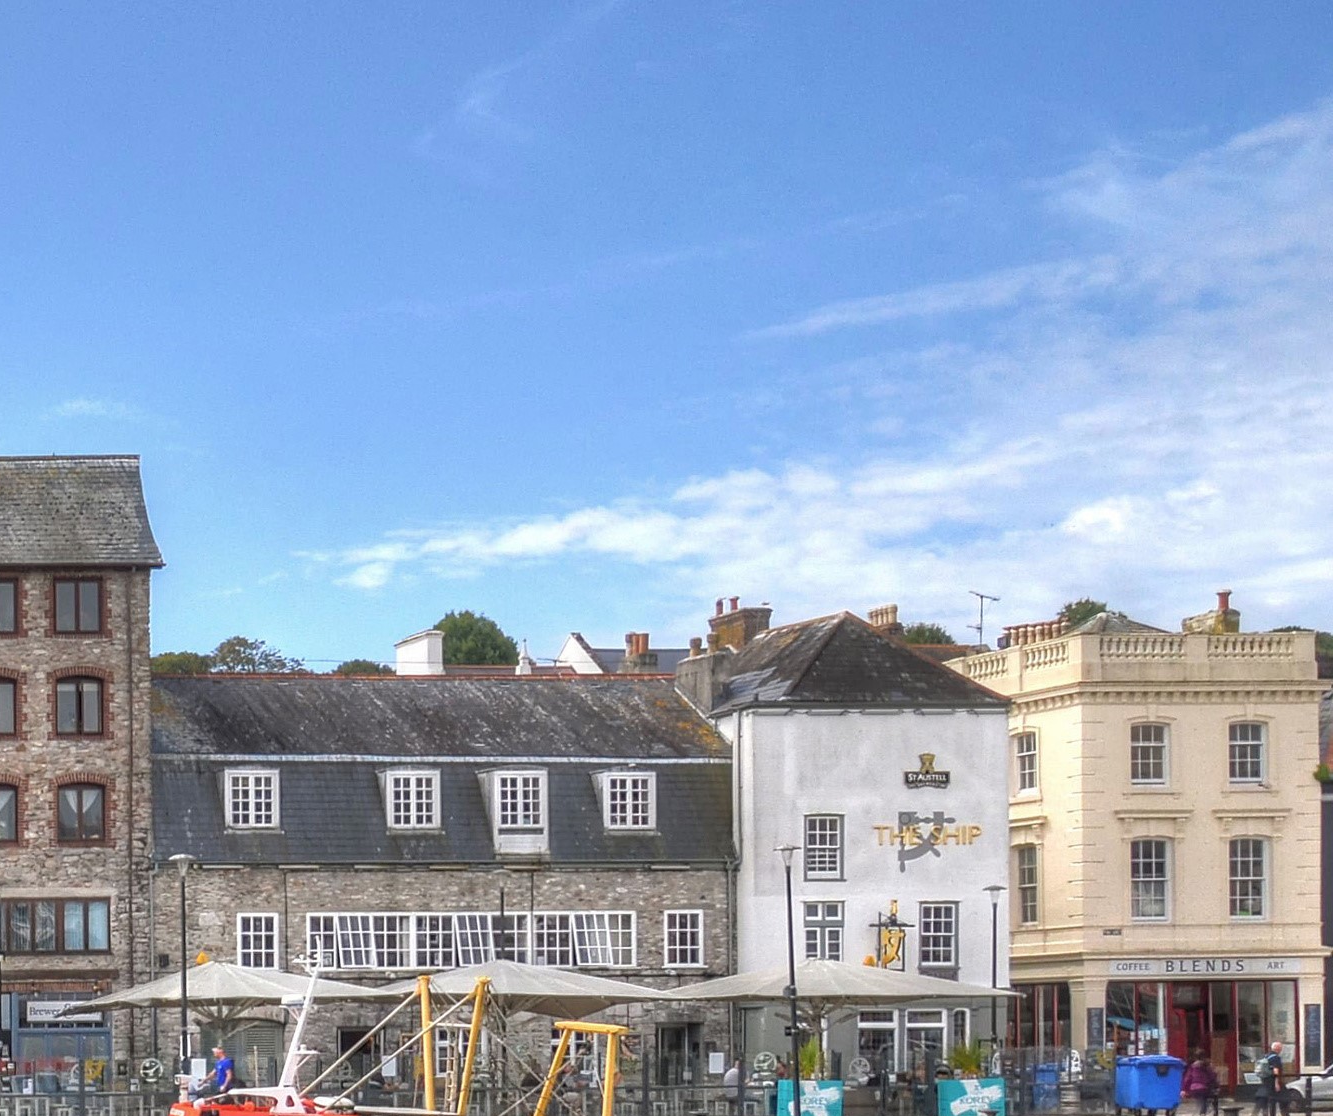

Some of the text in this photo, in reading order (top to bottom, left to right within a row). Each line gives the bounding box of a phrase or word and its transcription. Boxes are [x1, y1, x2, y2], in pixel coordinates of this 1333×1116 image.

[873, 825, 982, 846] THE SHIP
[1116, 960, 1285, 973] COFFEE BLENDS ART
